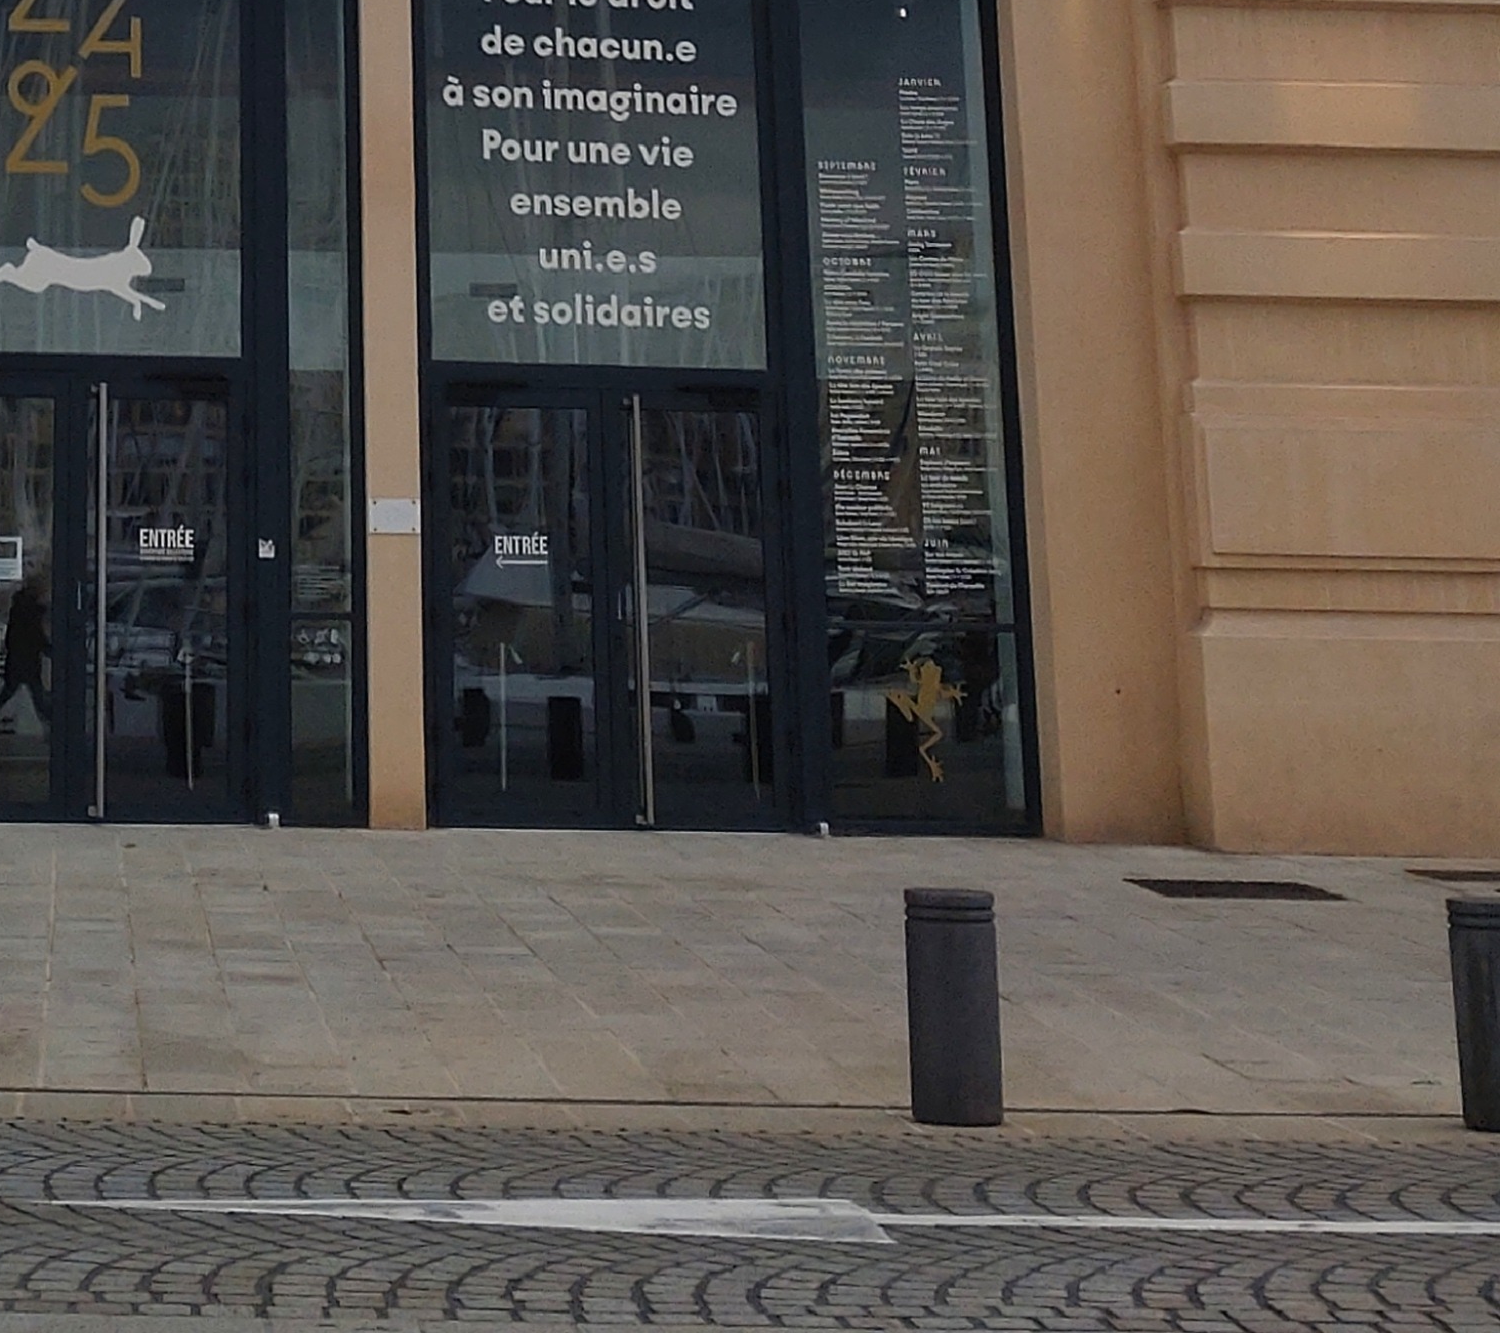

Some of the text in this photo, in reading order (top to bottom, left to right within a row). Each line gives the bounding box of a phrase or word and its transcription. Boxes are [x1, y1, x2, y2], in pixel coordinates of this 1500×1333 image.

[481, 25, 697, 62] de chacun.e
[442, 75, 737, 121] à son imaginaire
[482, 128, 694, 168] Pour une vie
[510, 187, 682, 220] ensemble
[539, 240, 657, 273] uni.e.s
[488, 293, 711, 329] et solidaires
[139, 524, 194, 549] ENTRÉE
[494, 531, 548, 555] ENTRÉE
